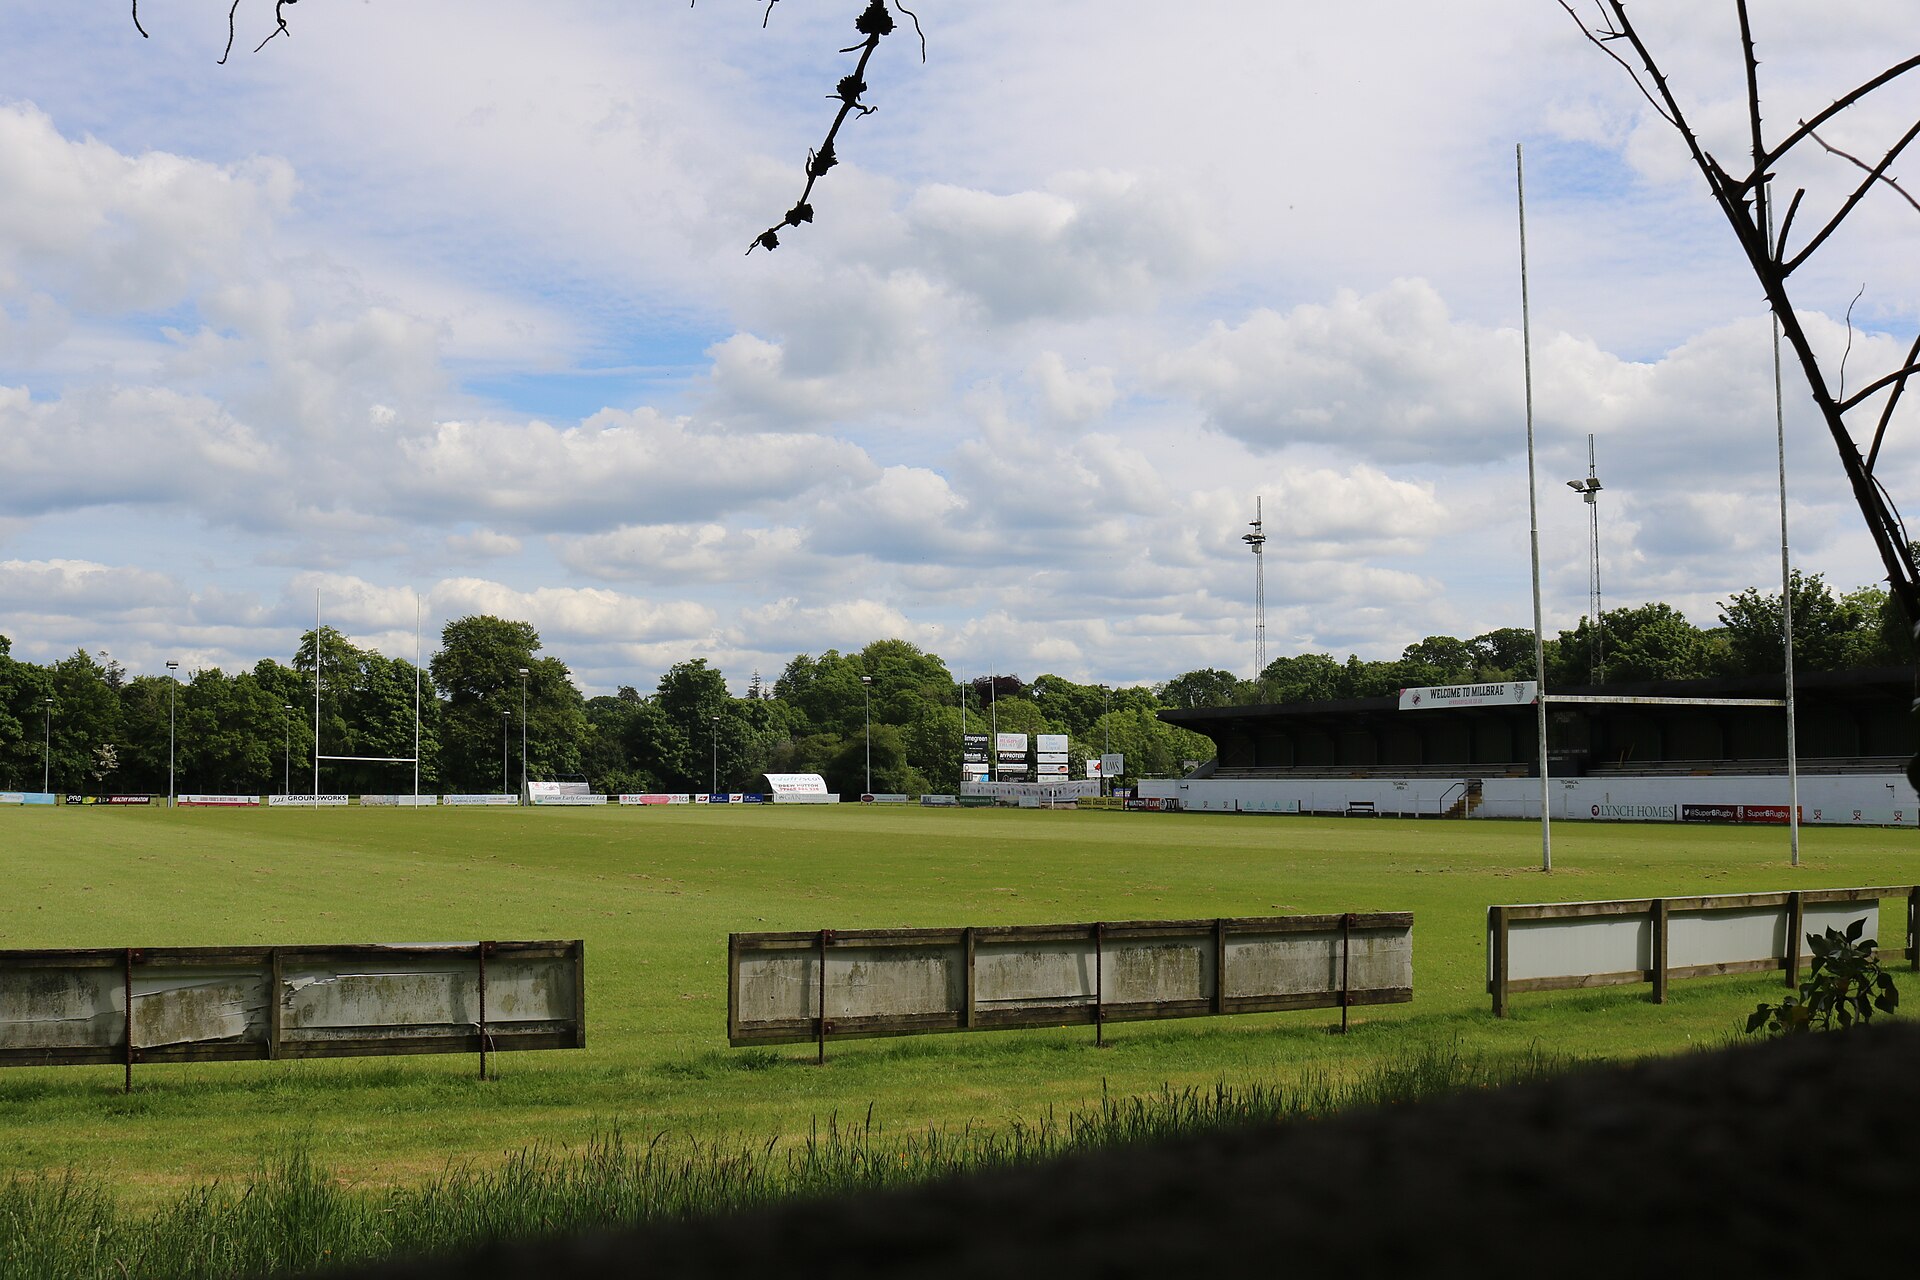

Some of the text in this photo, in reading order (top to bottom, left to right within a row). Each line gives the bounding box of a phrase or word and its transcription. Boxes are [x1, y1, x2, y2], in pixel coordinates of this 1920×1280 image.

[1430, 685, 1504, 699] WELCOME TO MILLBRAE
[1601, 805, 1674, 818] LYNCH HOMES
[1690, 808, 1734, 818] @Super6Rugby
